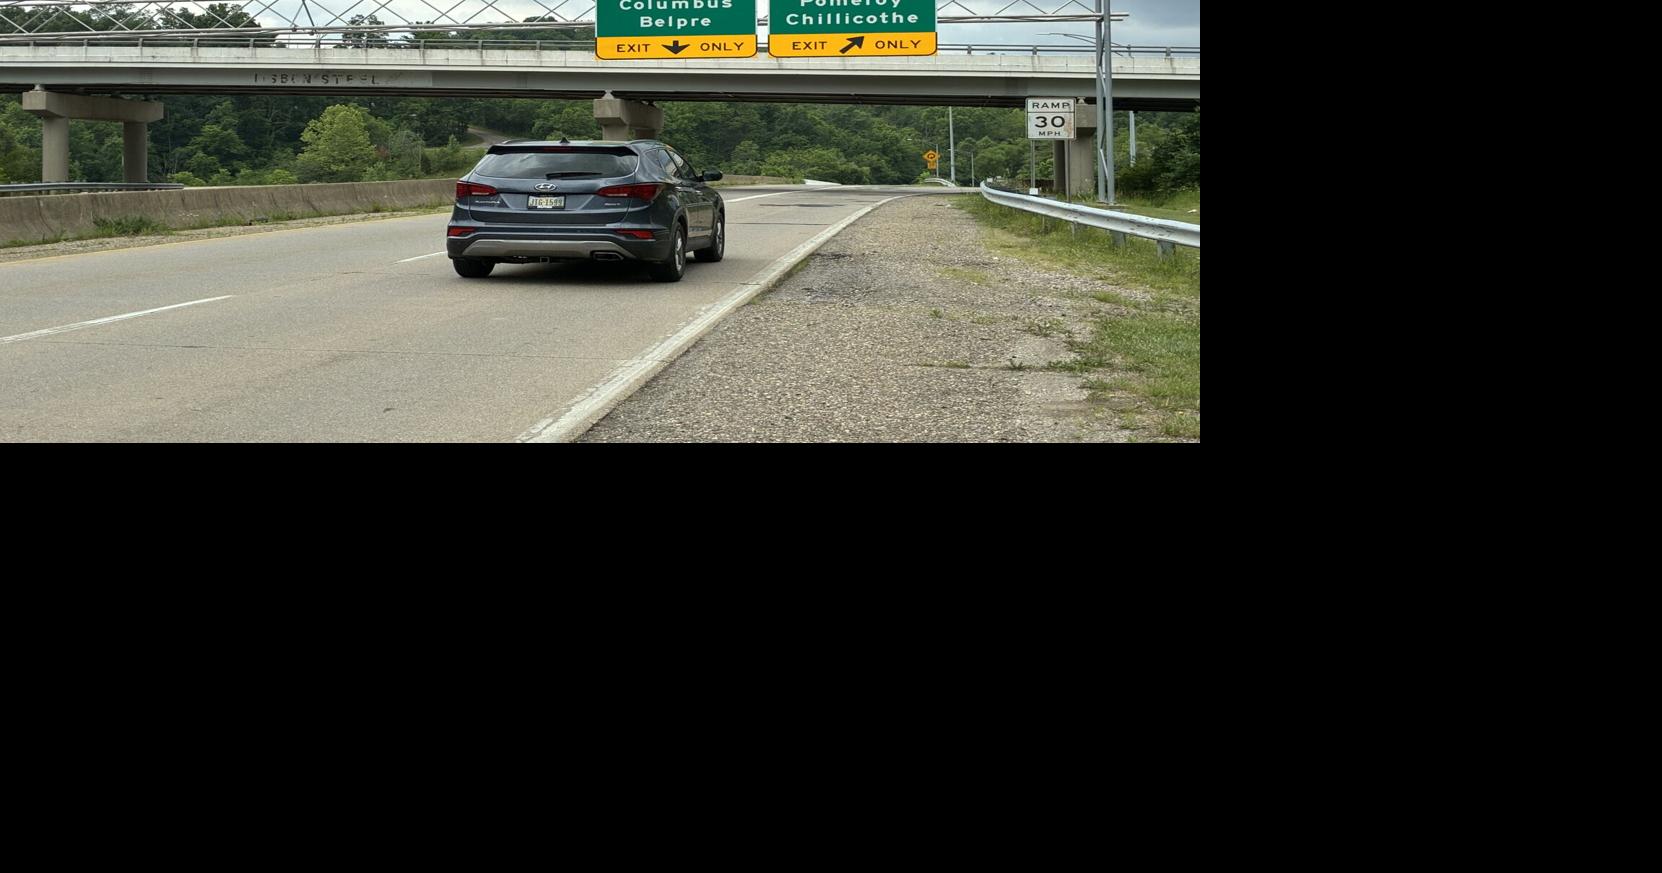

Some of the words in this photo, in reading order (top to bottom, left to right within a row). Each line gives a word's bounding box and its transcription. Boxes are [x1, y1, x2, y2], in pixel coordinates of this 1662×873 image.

[619, 0, 733, 10] Columbus
[800, 0, 900, 8] Pomeroy
[639, 16, 712, 29] Belpre
[786, 12, 919, 25] Chillicothe
[616, 43, 652, 53] EXIT
[700, 42, 745, 52] ONLY
[792, 41, 828, 51] EXIT
[875, 39, 922, 49] ONLY
[1034, 115, 1066, 128] 30
